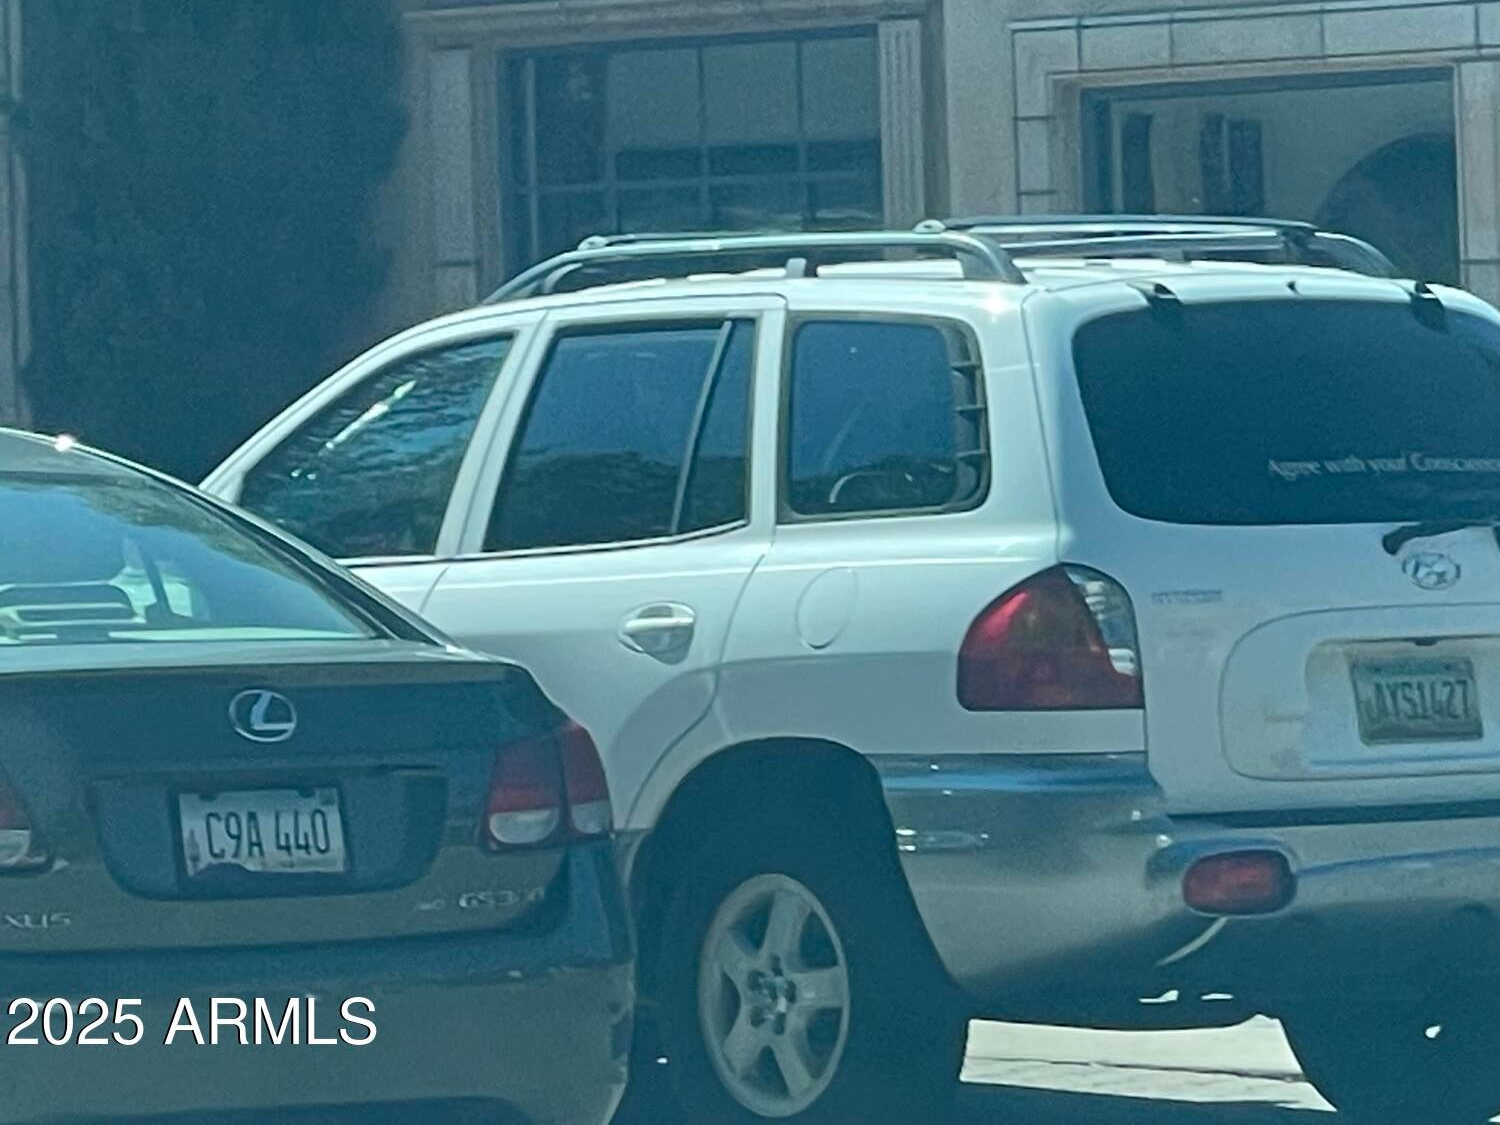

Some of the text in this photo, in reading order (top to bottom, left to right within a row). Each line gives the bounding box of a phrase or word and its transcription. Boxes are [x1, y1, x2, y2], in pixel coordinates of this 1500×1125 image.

[1324, 454, 1367, 474] with
[1366, 455, 1407, 477] your
[205, 807, 330, 860] C9A 440
